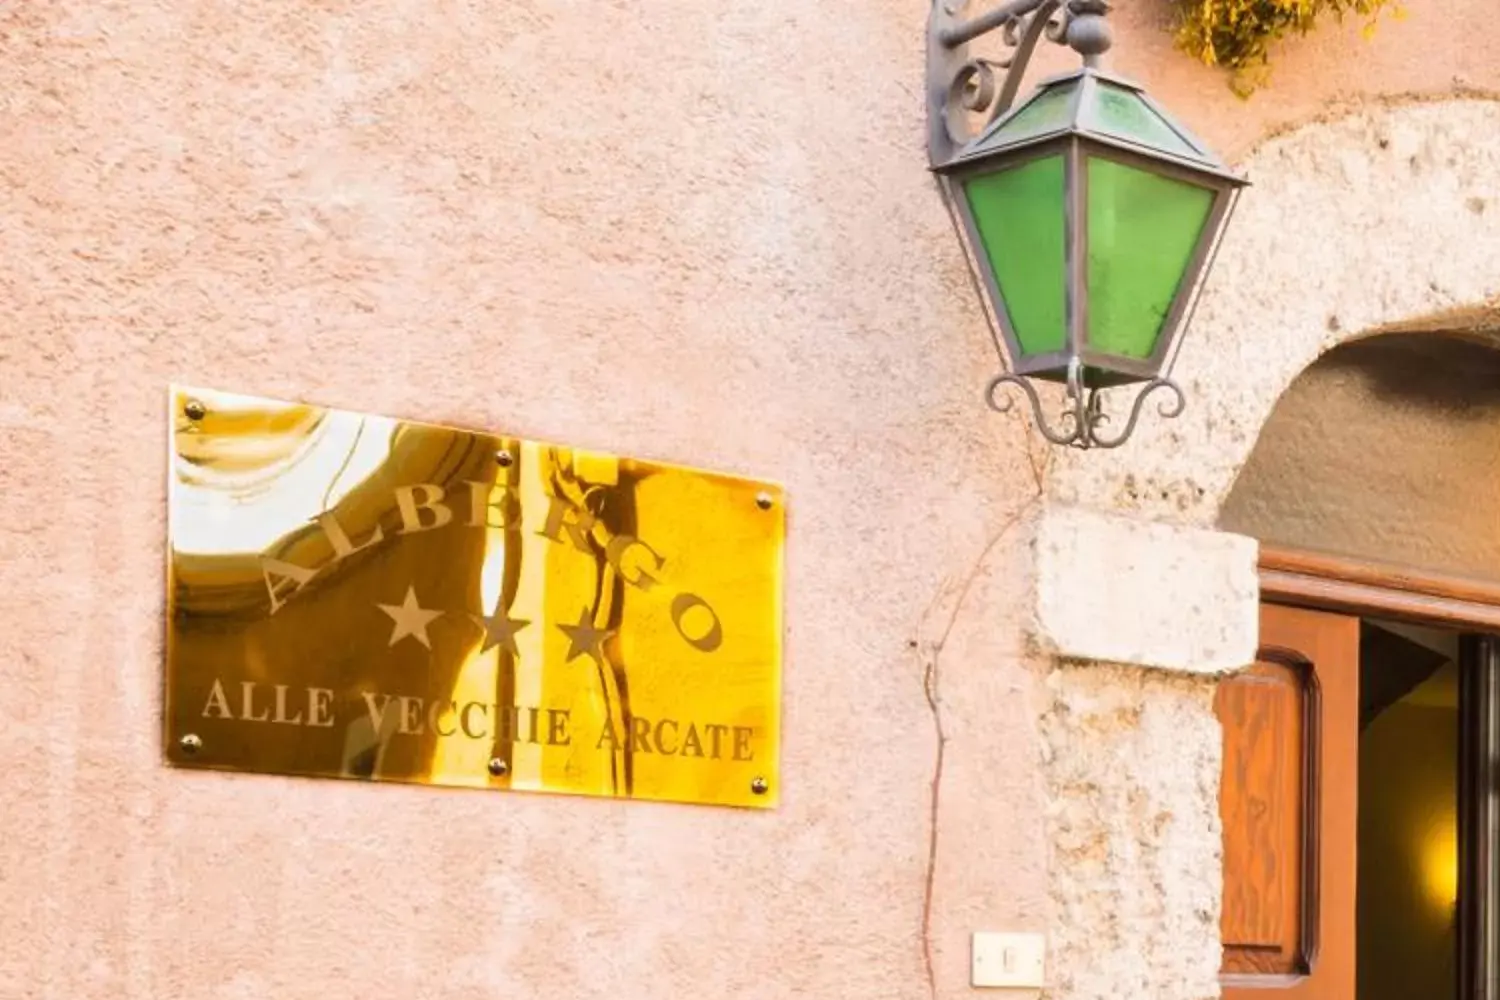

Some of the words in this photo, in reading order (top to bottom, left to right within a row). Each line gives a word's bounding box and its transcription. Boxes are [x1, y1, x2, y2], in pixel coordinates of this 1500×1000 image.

[257, 479, 723, 653] ALBERGO
[201, 677, 336, 727] ALLE
[361, 690, 571, 746] VECCHIE
[596, 714, 755, 762] ARCATE
